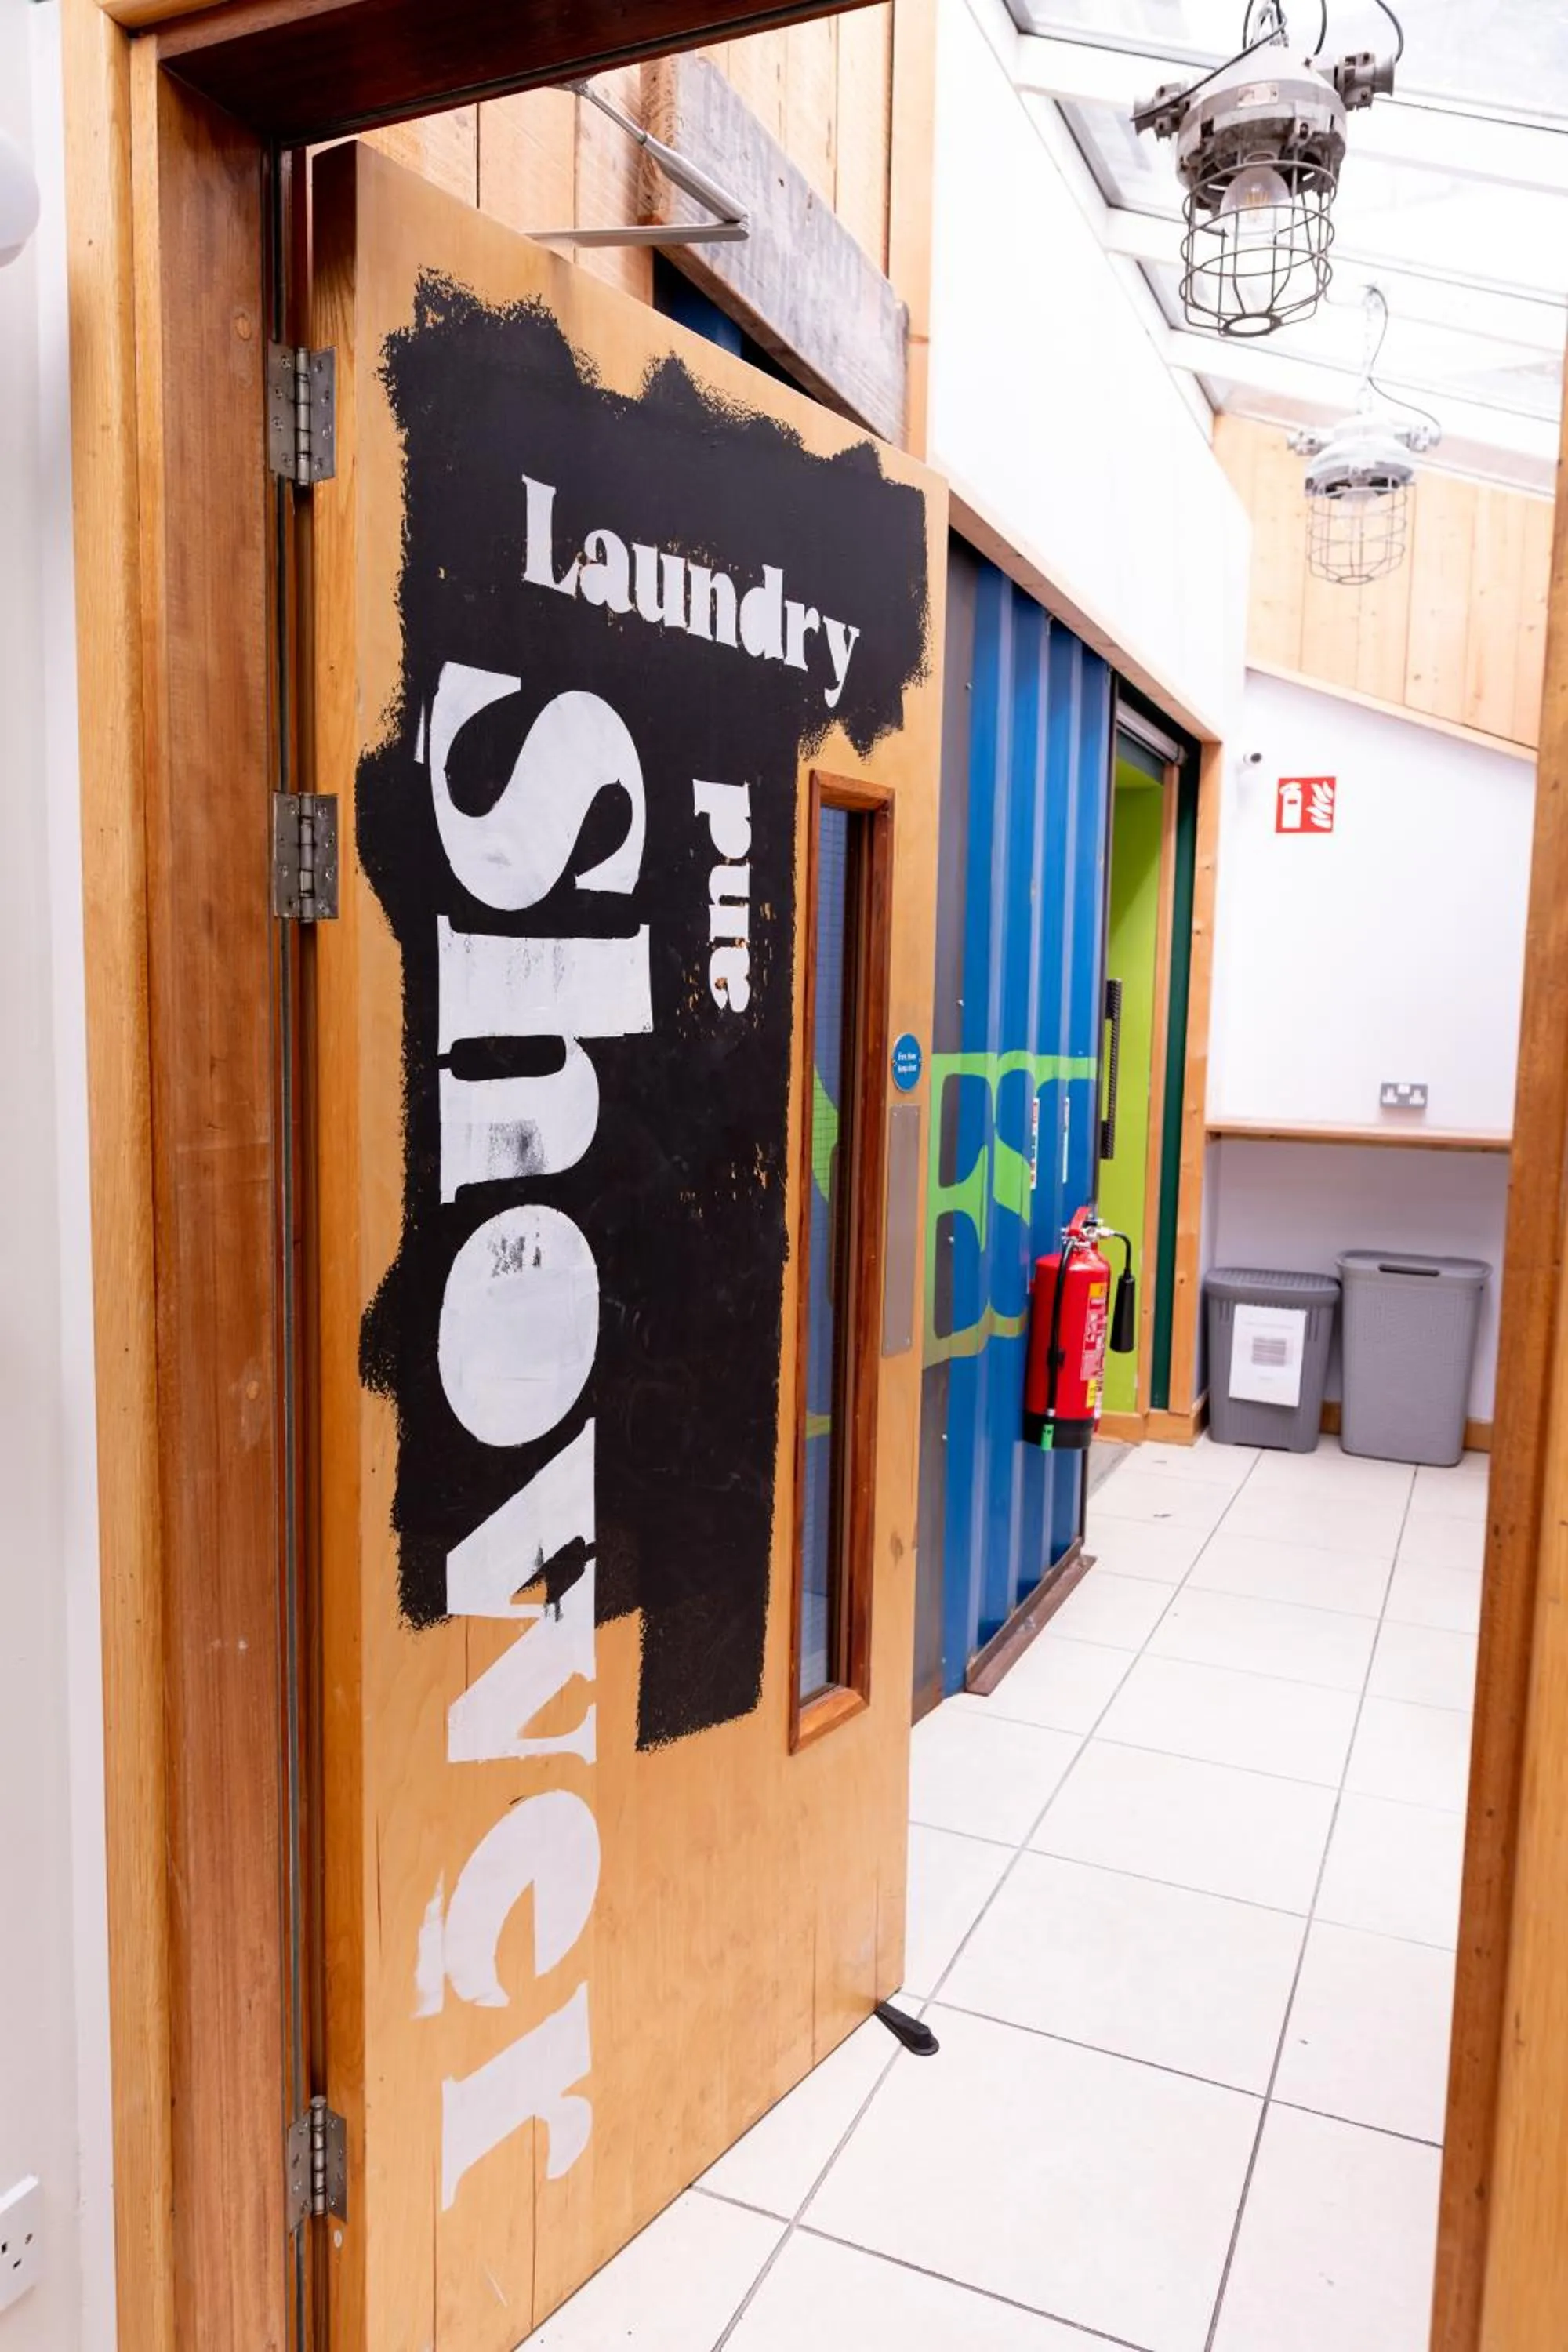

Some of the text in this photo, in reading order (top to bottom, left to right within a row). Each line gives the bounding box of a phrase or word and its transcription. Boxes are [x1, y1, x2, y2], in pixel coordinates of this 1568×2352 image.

[521, 474, 861, 709] Laundry
[692, 779, 752, 1014] and
[423, 661, 653, 2212] Shower
